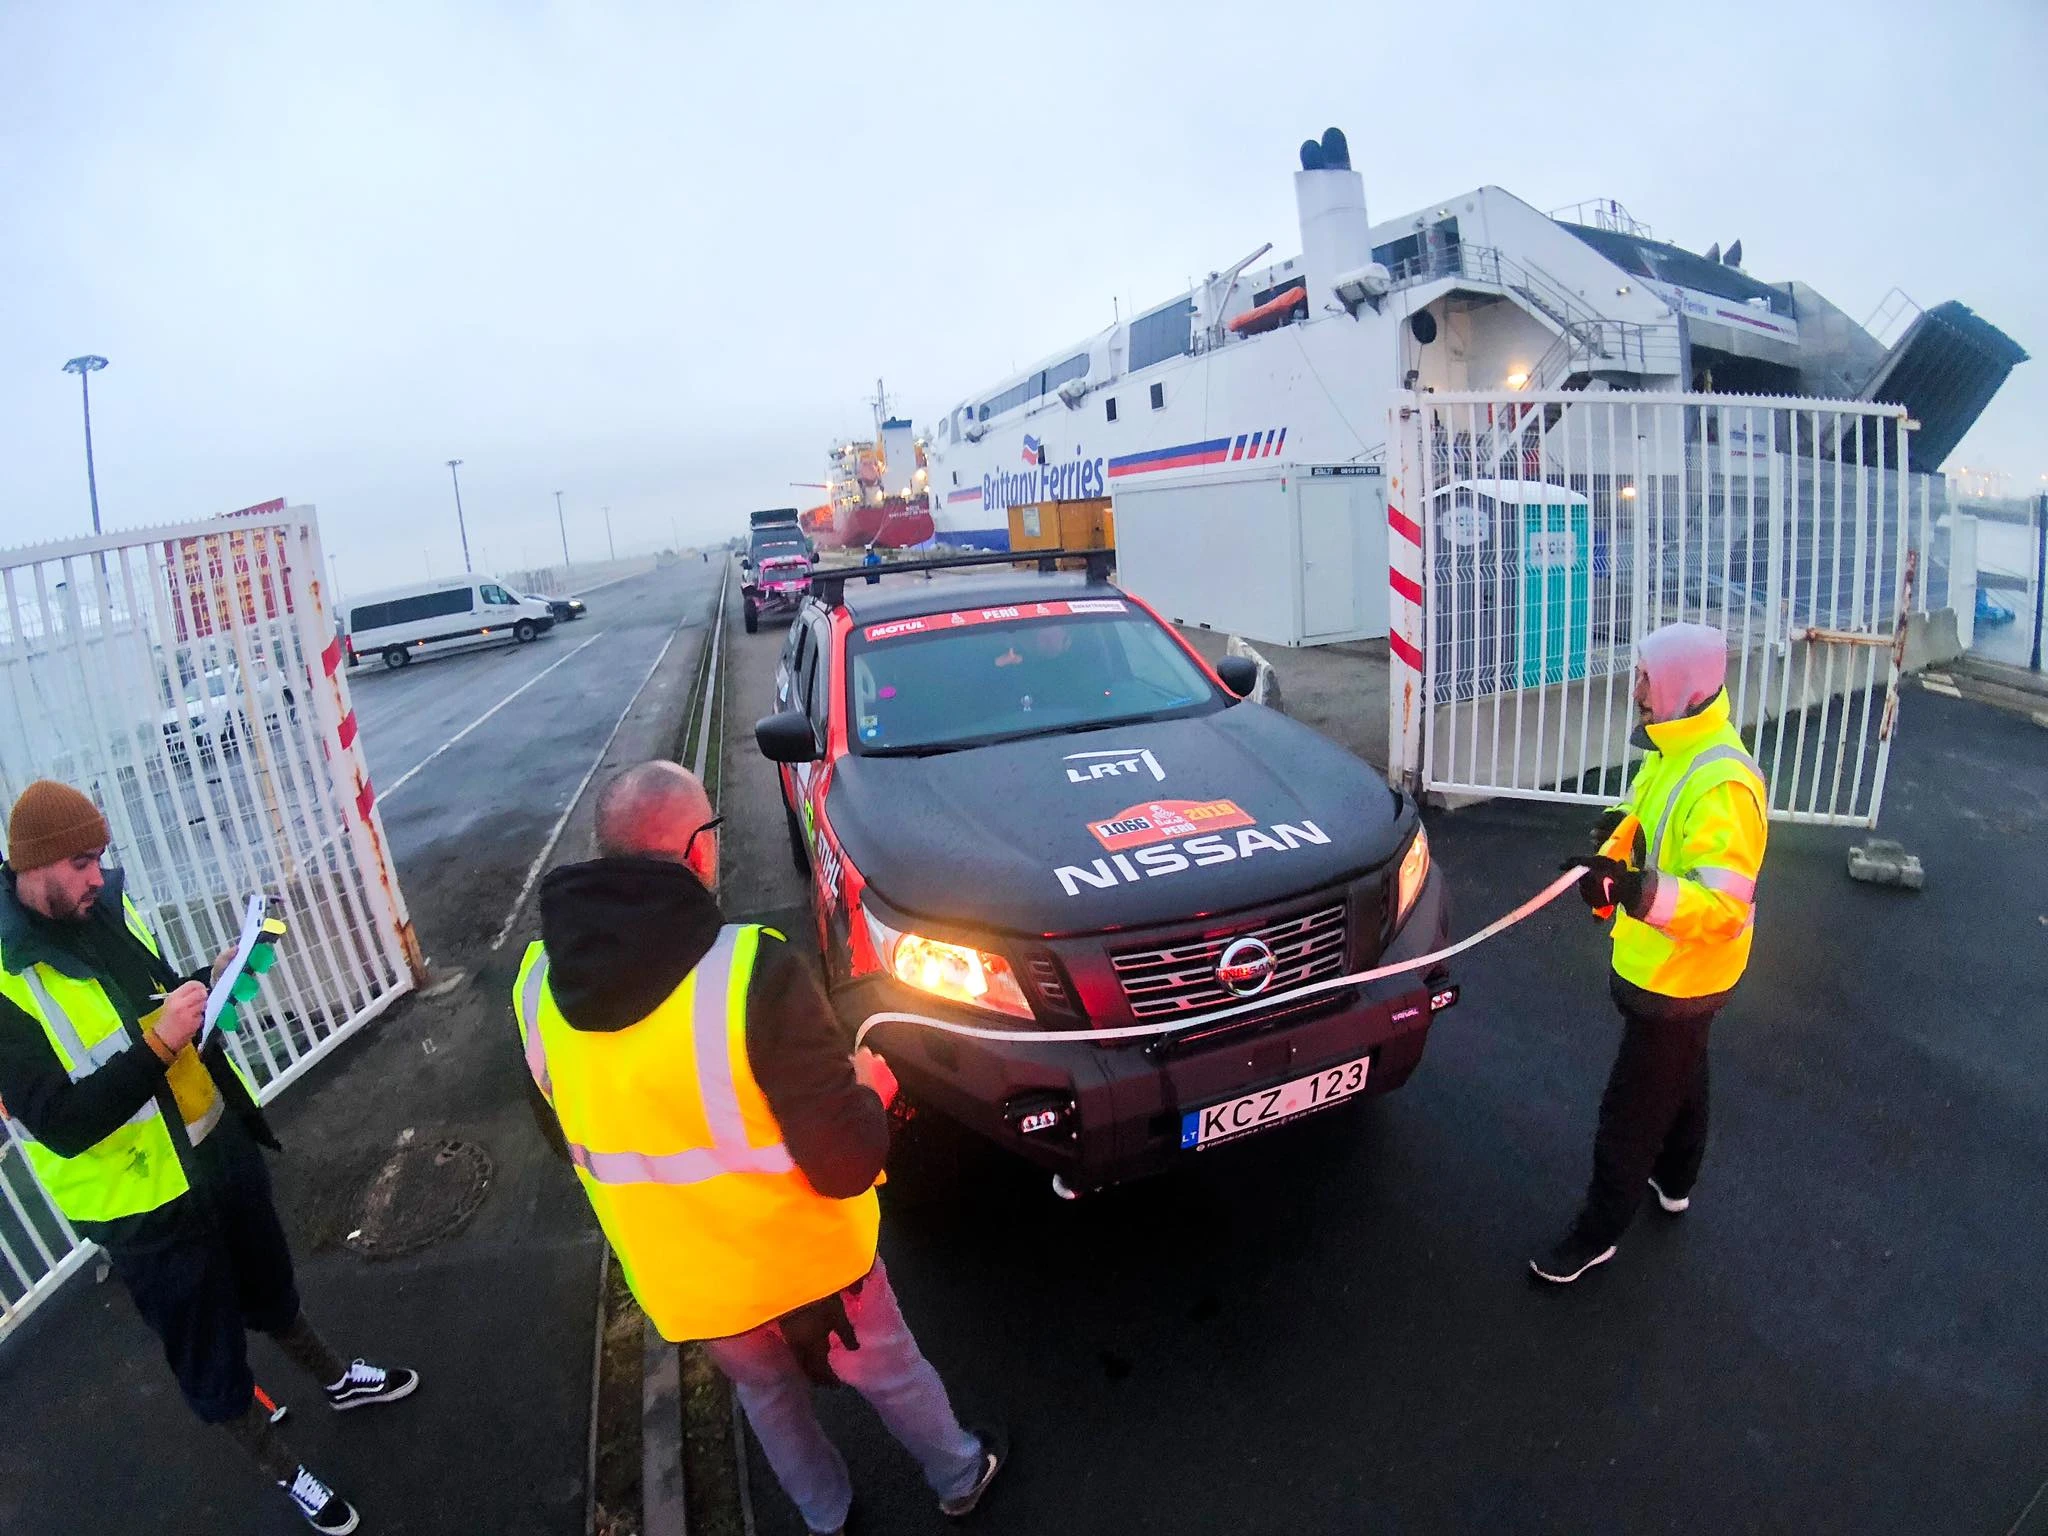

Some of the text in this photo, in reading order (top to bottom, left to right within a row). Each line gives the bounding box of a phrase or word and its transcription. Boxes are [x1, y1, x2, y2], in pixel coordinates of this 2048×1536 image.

[983, 444, 1104, 511] Brittany Ferries
[871, 620, 926, 638] MOTUL
[982, 606, 1019, 619] PERÚ
[1066, 758, 1141, 783] LRT
[1099, 817, 1151, 838] 1066
[1183, 803, 1236, 820] 2019
[818, 828, 840, 898] STIHL
[1053, 820, 1332, 896] NISSAN
[1204, 1089, 1282, 1138] KCZ
[1309, 1063, 1363, 1104] 123
[1182, 1131, 1197, 1143] LT
